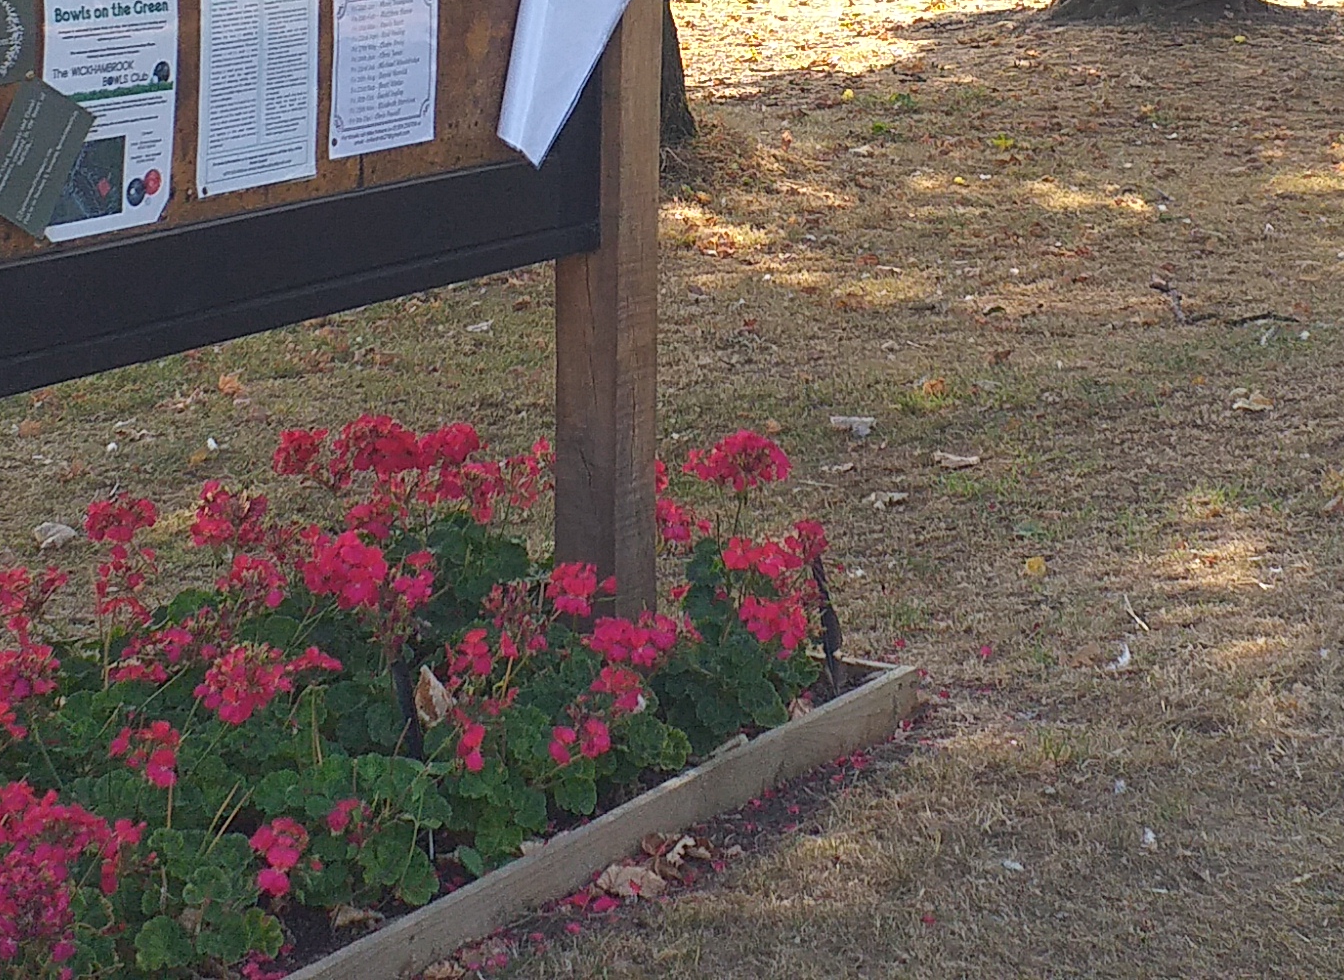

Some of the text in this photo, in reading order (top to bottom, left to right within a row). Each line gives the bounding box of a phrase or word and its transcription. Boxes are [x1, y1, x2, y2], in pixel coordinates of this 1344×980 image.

[54, 0, 169, 23] Bowls on the Green
[52, 68, 69, 79] The
[102, 72, 149, 87] BOWLS Club
